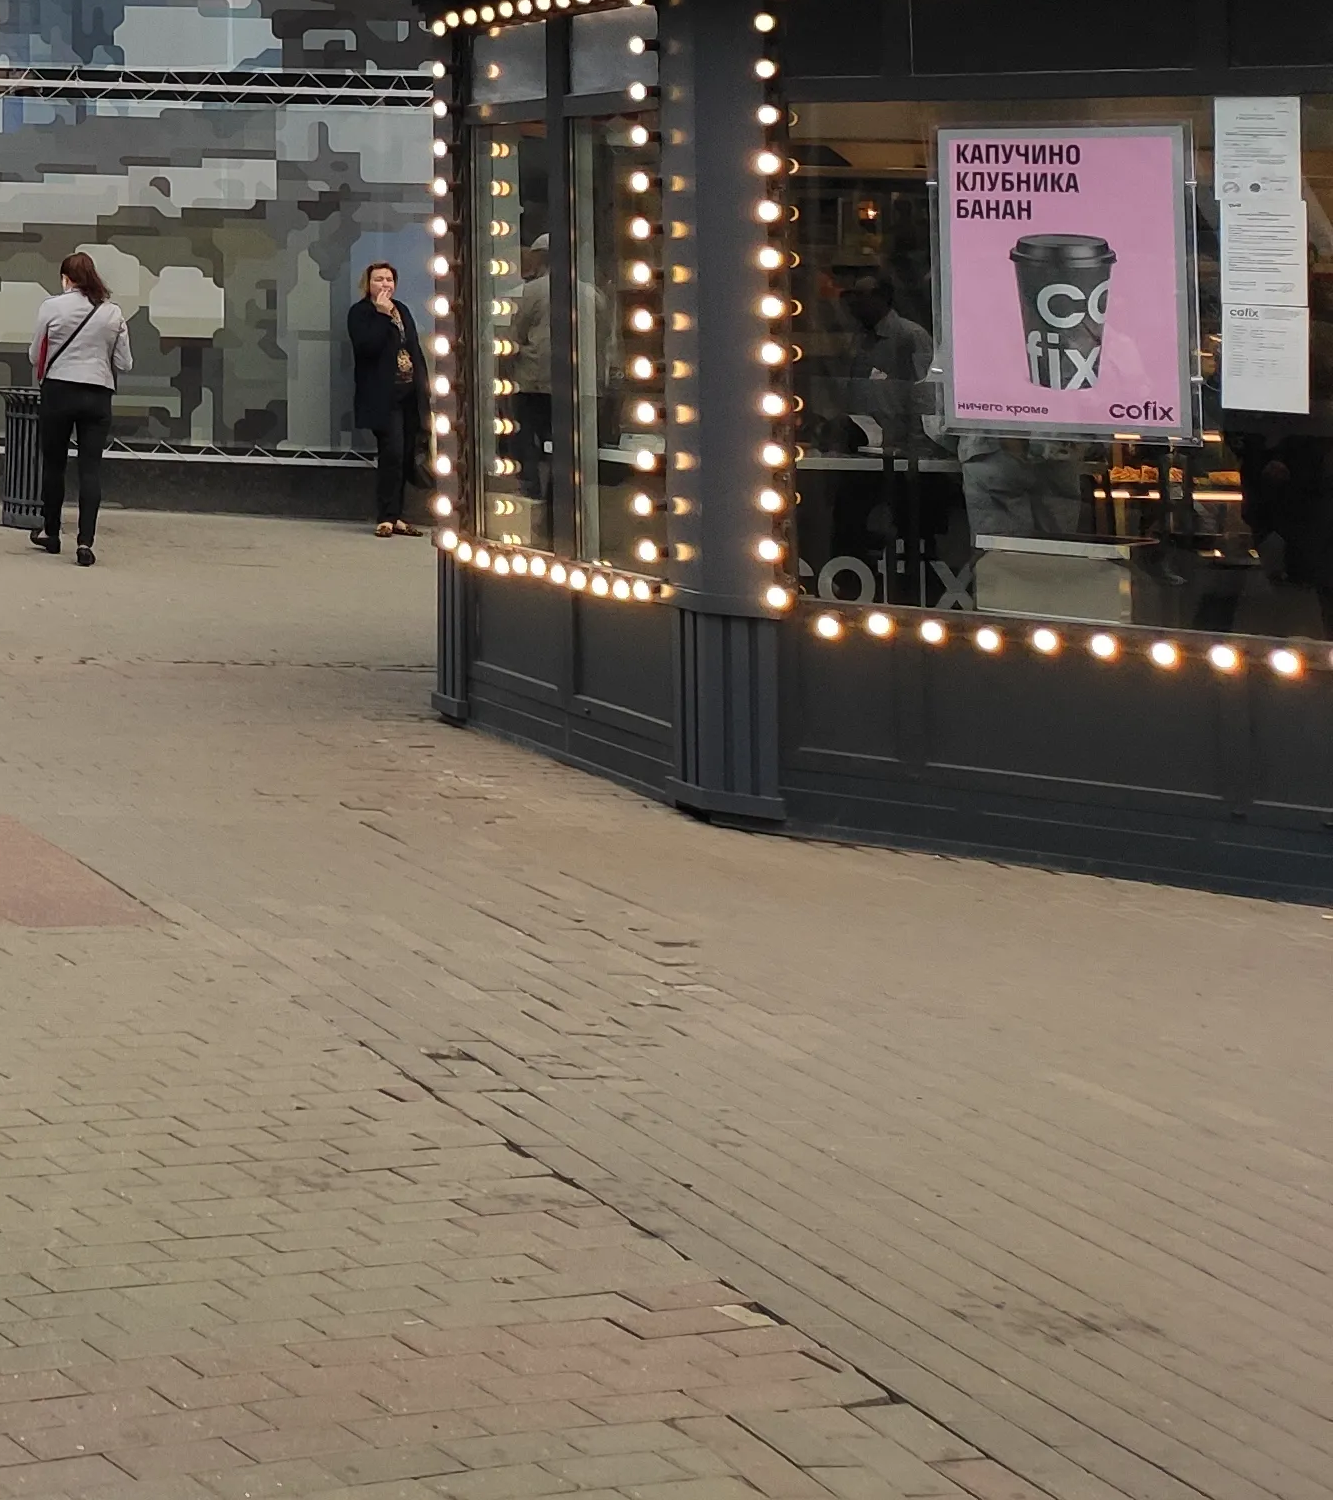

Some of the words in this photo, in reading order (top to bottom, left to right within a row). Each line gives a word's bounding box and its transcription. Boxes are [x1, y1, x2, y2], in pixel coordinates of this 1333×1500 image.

[955, 143, 1081, 166] КАПУЧИНО
[955, 171, 1080, 194] КЛУБНИКА
[955, 198, 1032, 221] БАНАН
[1229, 307, 1259, 318] cofix
[1027, 330, 1102, 390] fix
[957, 401, 1003, 412] ничего
[1006, 403, 1049, 416] кроме
[1109, 401, 1175, 421] cofix
